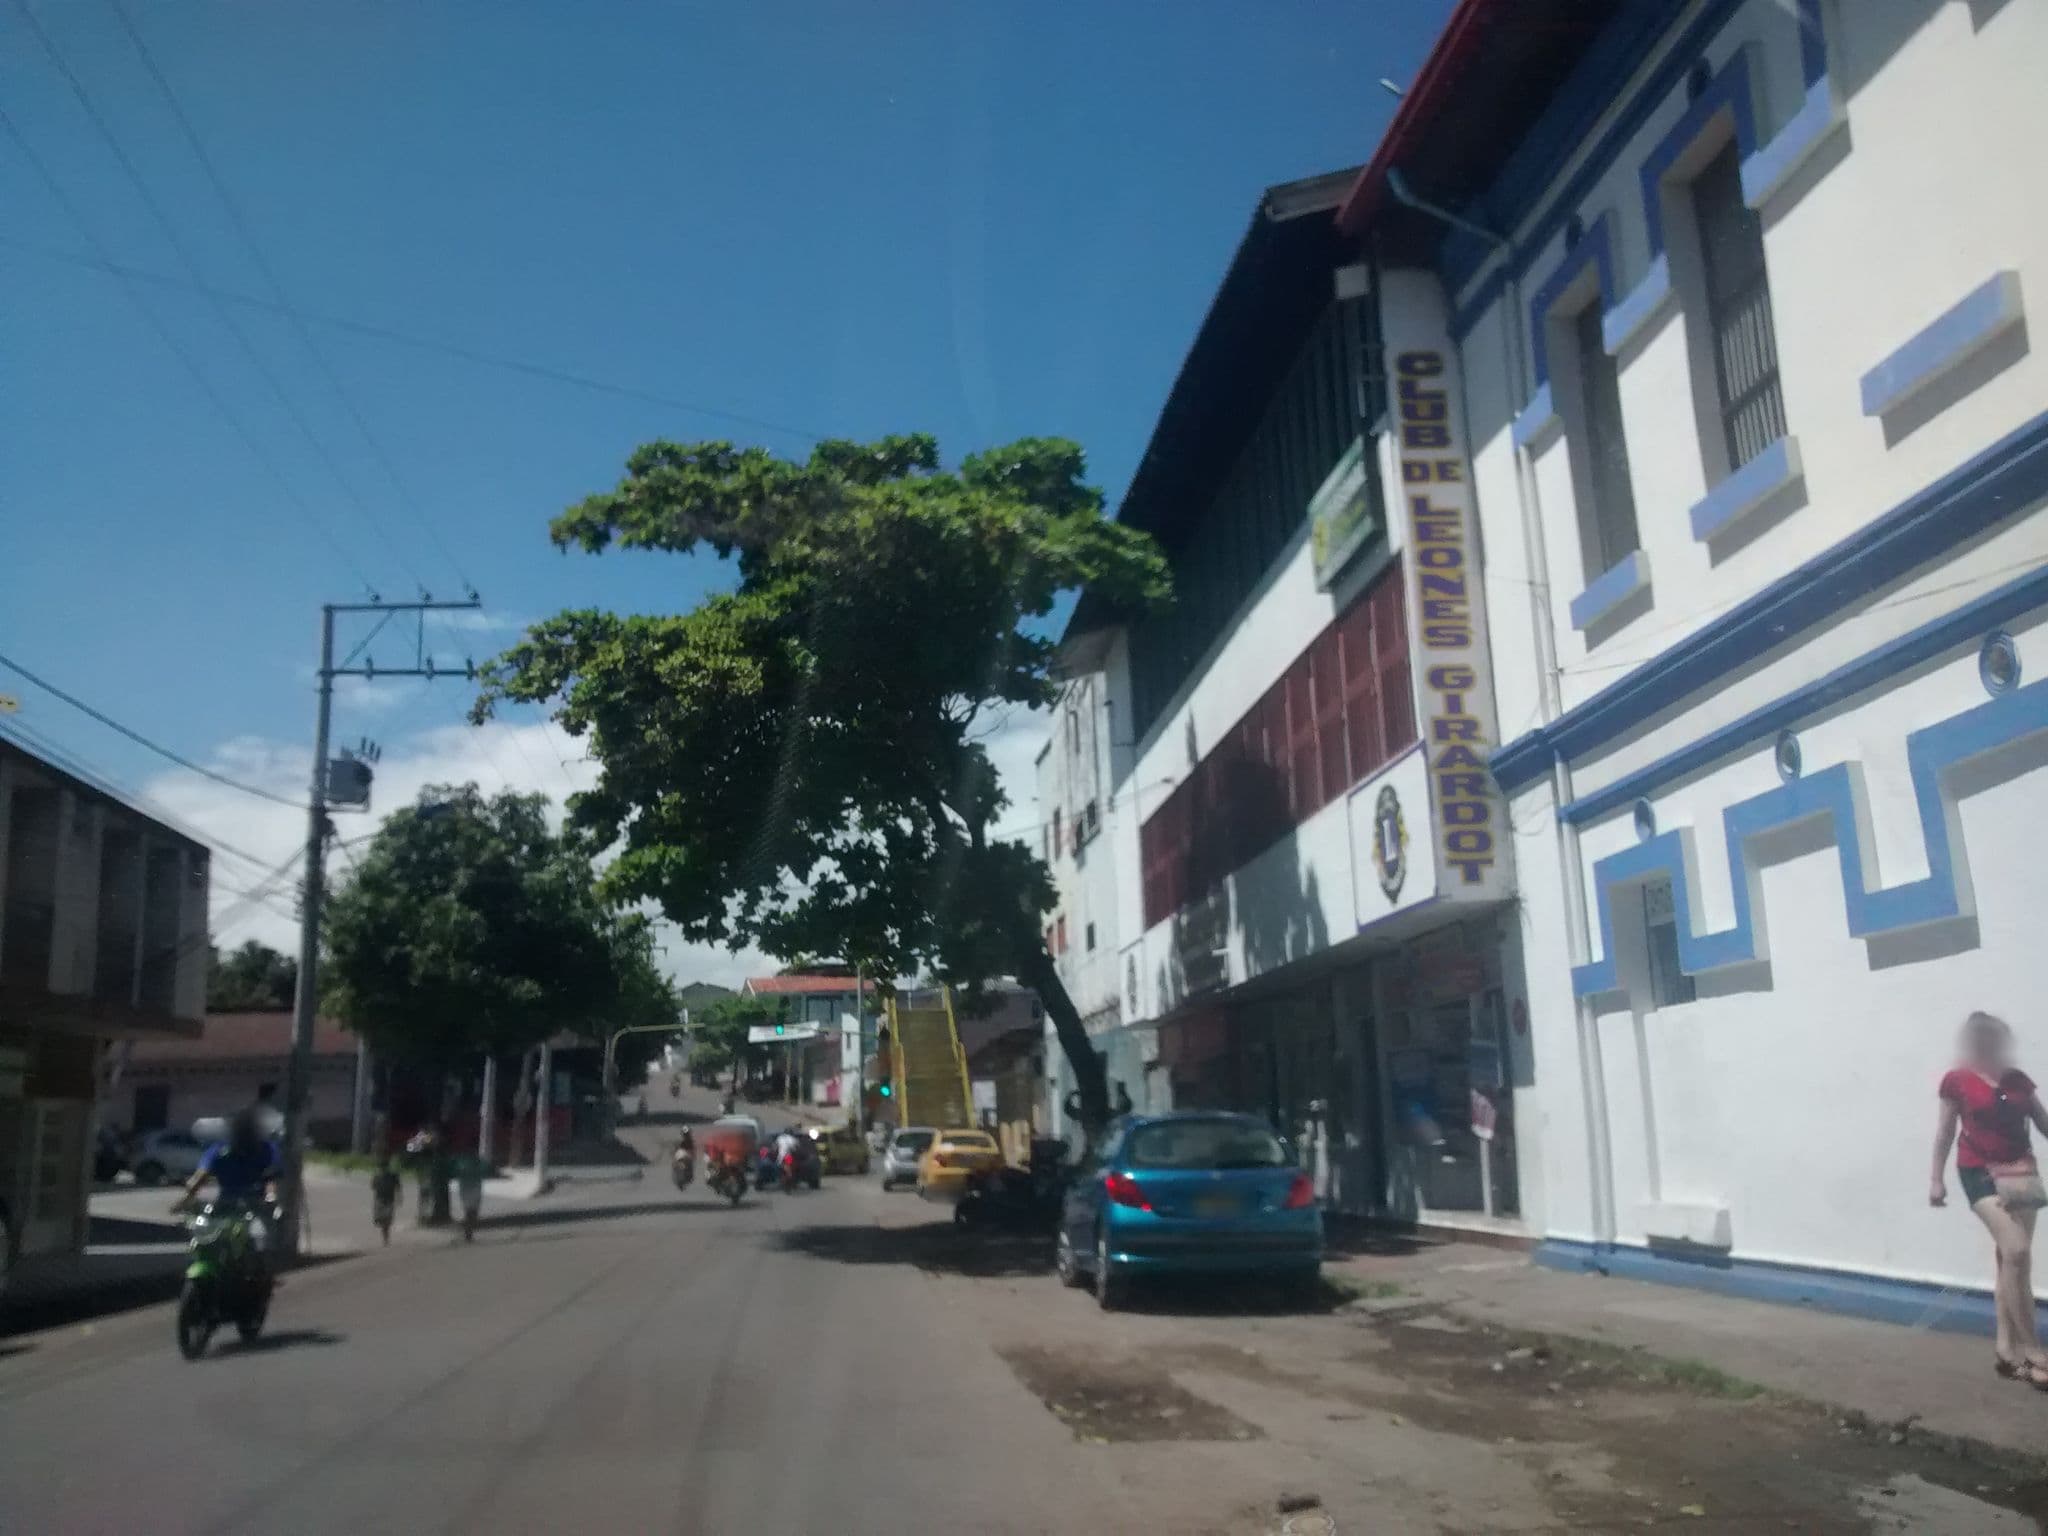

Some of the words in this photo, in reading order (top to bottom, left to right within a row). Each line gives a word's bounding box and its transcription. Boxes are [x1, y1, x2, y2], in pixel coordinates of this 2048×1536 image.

[1395, 352, 1449, 448] CLUB
[1402, 459, 1461, 482] DE
[1412, 496, 1473, 651] LEONES
[1426, 665, 1494, 884] GIRARDOT
